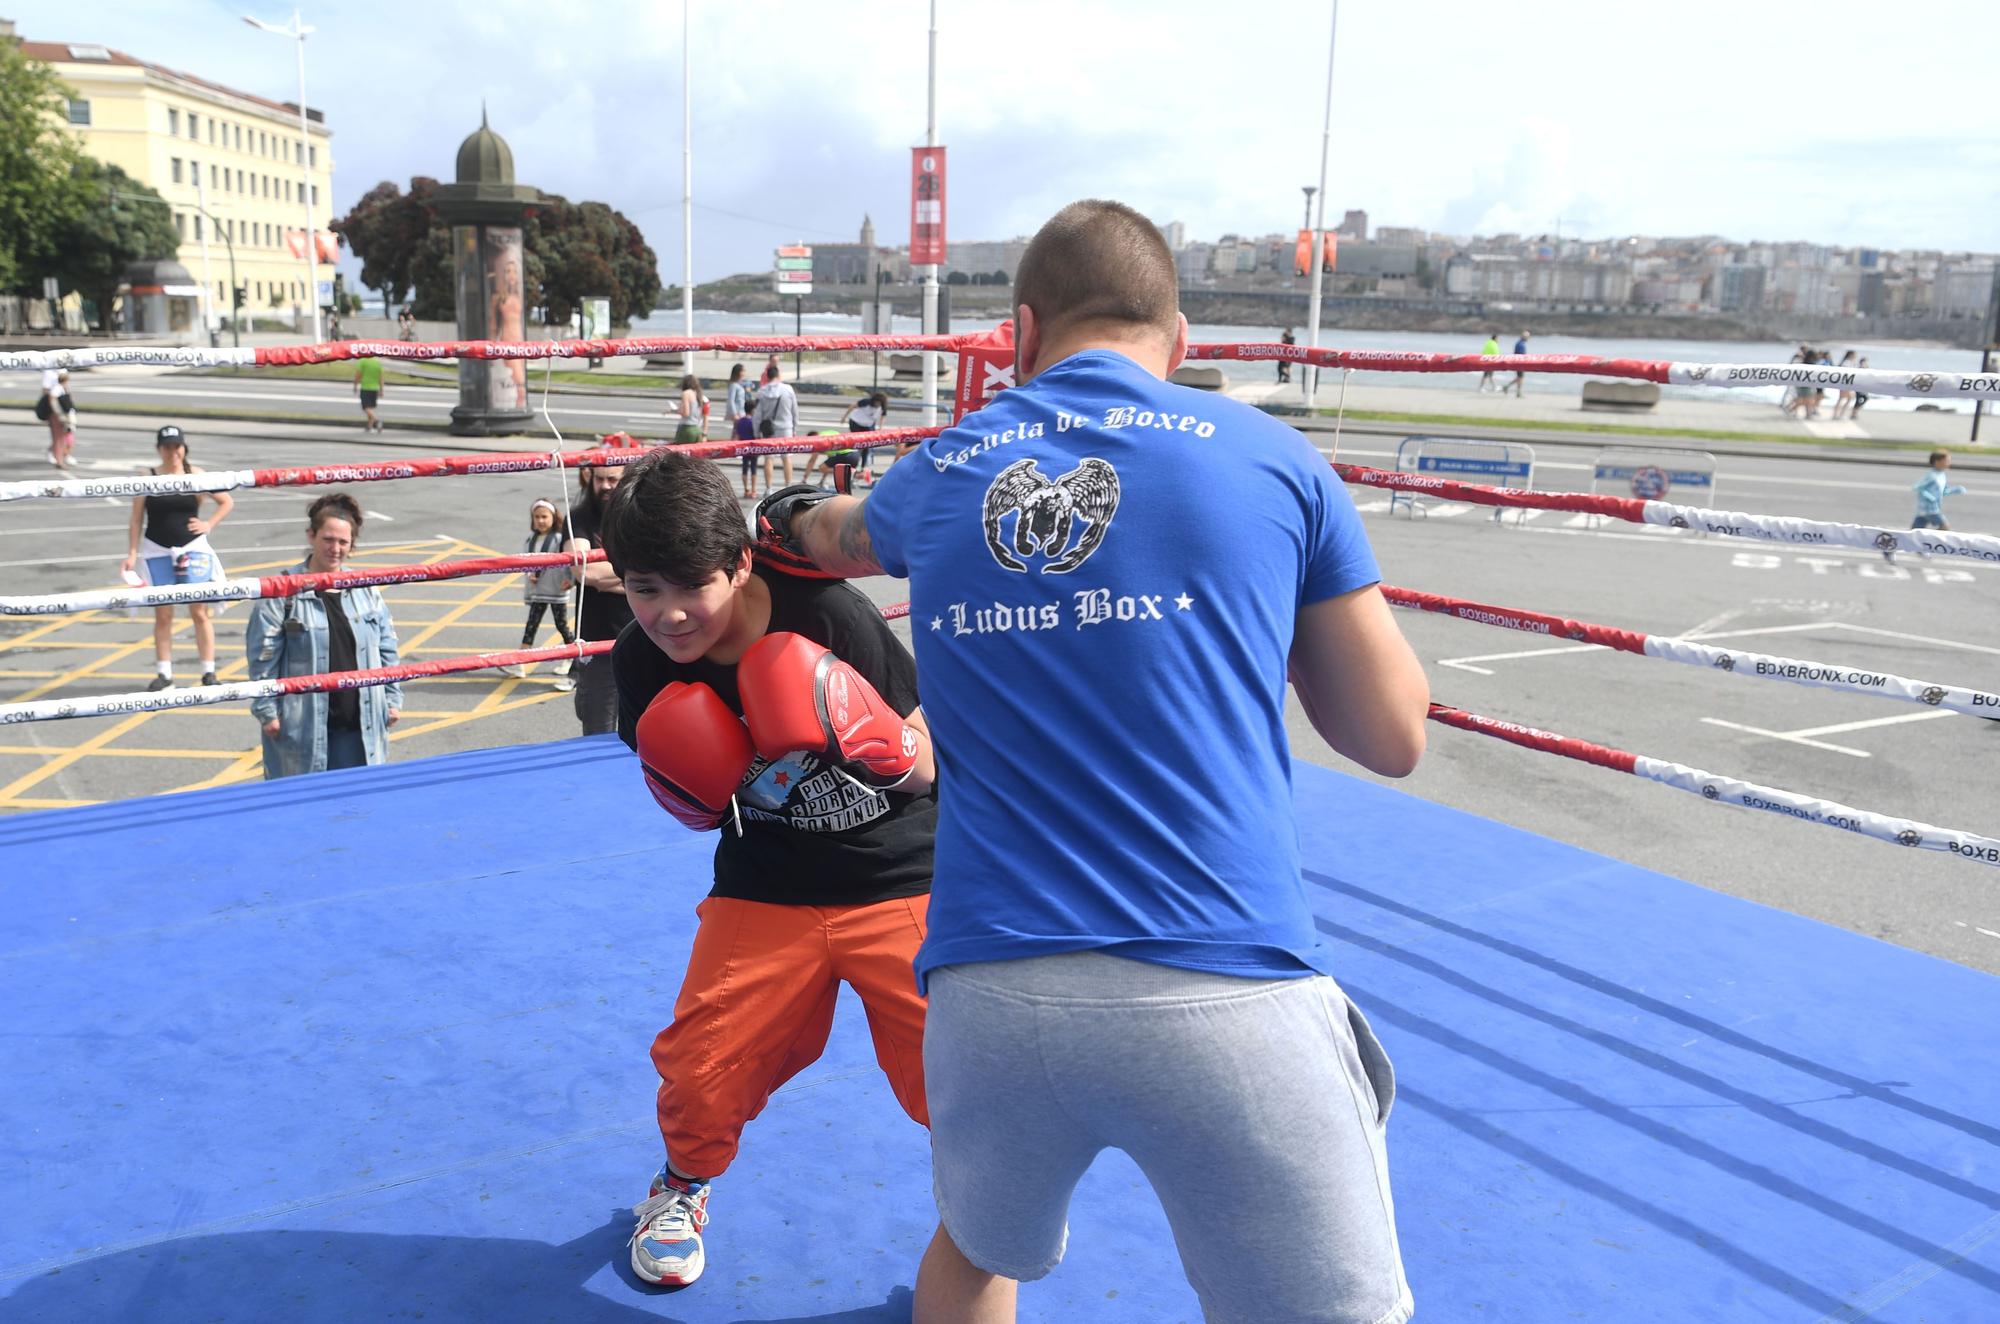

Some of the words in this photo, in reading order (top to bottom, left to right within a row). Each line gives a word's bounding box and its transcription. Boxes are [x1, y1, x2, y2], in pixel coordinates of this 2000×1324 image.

[350, 343, 445, 357] BOXBRONX.COM
[485, 344, 574, 356] BOXBRONX.COM
[1238, 345, 1308, 359] BOXBRONX.COM
[1349, 350, 1434, 362] BOXBRONX.COM
[1728, 367, 1855, 385] BOXBRONX.COM
[1960, 378, 2000, 392] BOX
[1055, 411, 1089, 433] de
[1100, 406, 1216, 438] Boxeo
[735, 445, 813, 455] BOXBRONX.COM
[316, 467, 412, 482] BOXBRONX.COM
[467, 459, 550, 474] BOXBRONX.CO
[85, 480, 193, 496] BOXBRONX.COM
[333, 574, 428, 589] BOXBRONX.COM
[147, 585, 250, 603] BOXBRONX.COM
[949, 600, 1060, 638] Ludus
[1074, 588, 1163, 631] Box
[1458, 606, 1550, 634] BOXBRONX.COM
[1756, 661, 1887, 687] BOXBRONX.COM
[97, 694, 203, 714] BOXBRONX.COM
[801, 773, 833, 799] POR
[793, 794, 887, 831] CONTINUA
[808, 792, 840, 816] POR
